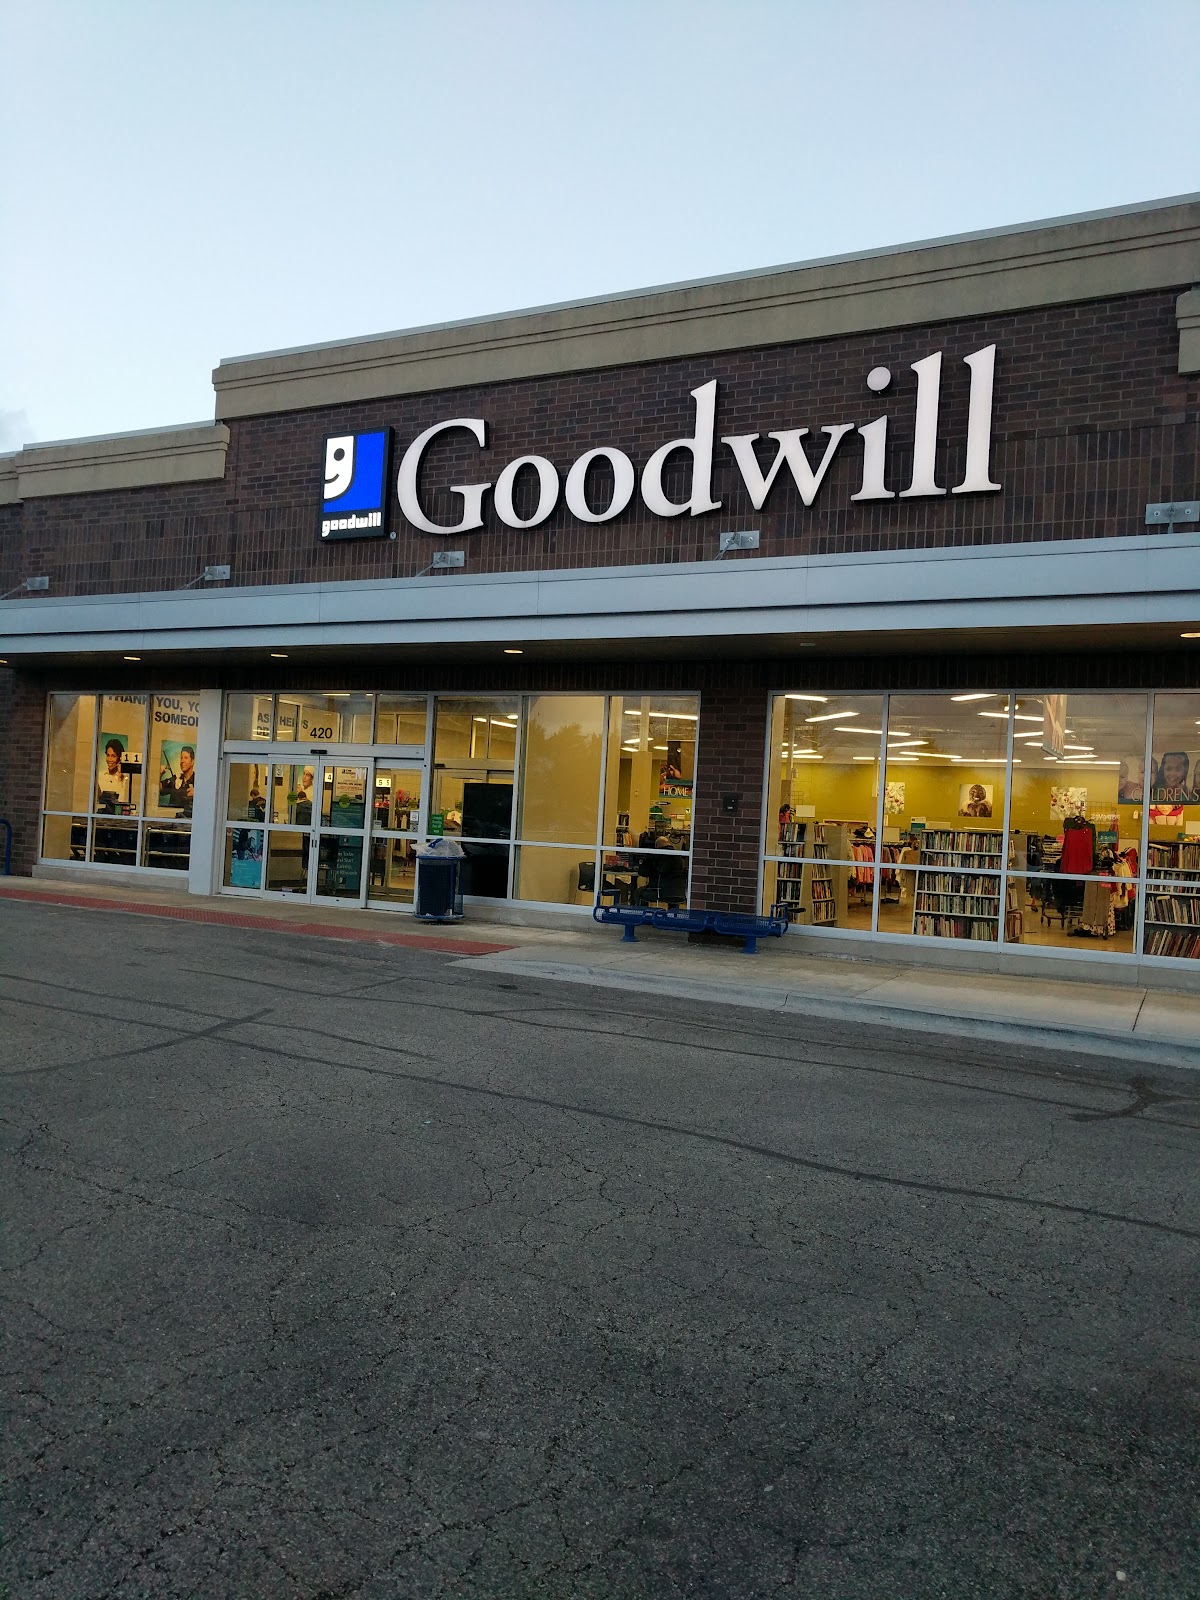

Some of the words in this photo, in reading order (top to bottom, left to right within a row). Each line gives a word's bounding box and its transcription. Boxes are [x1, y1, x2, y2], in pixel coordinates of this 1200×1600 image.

[396, 343, 1002, 535] Goodwill
[321, 511, 382, 537] goodwill
[156, 696, 183, 712] YOU,
[154, 711, 199, 728] SOMEO
[310, 727, 333, 739] 420
[663, 786, 690, 797] HOME
[1131, 787, 1200, 802] CLDREN'S
